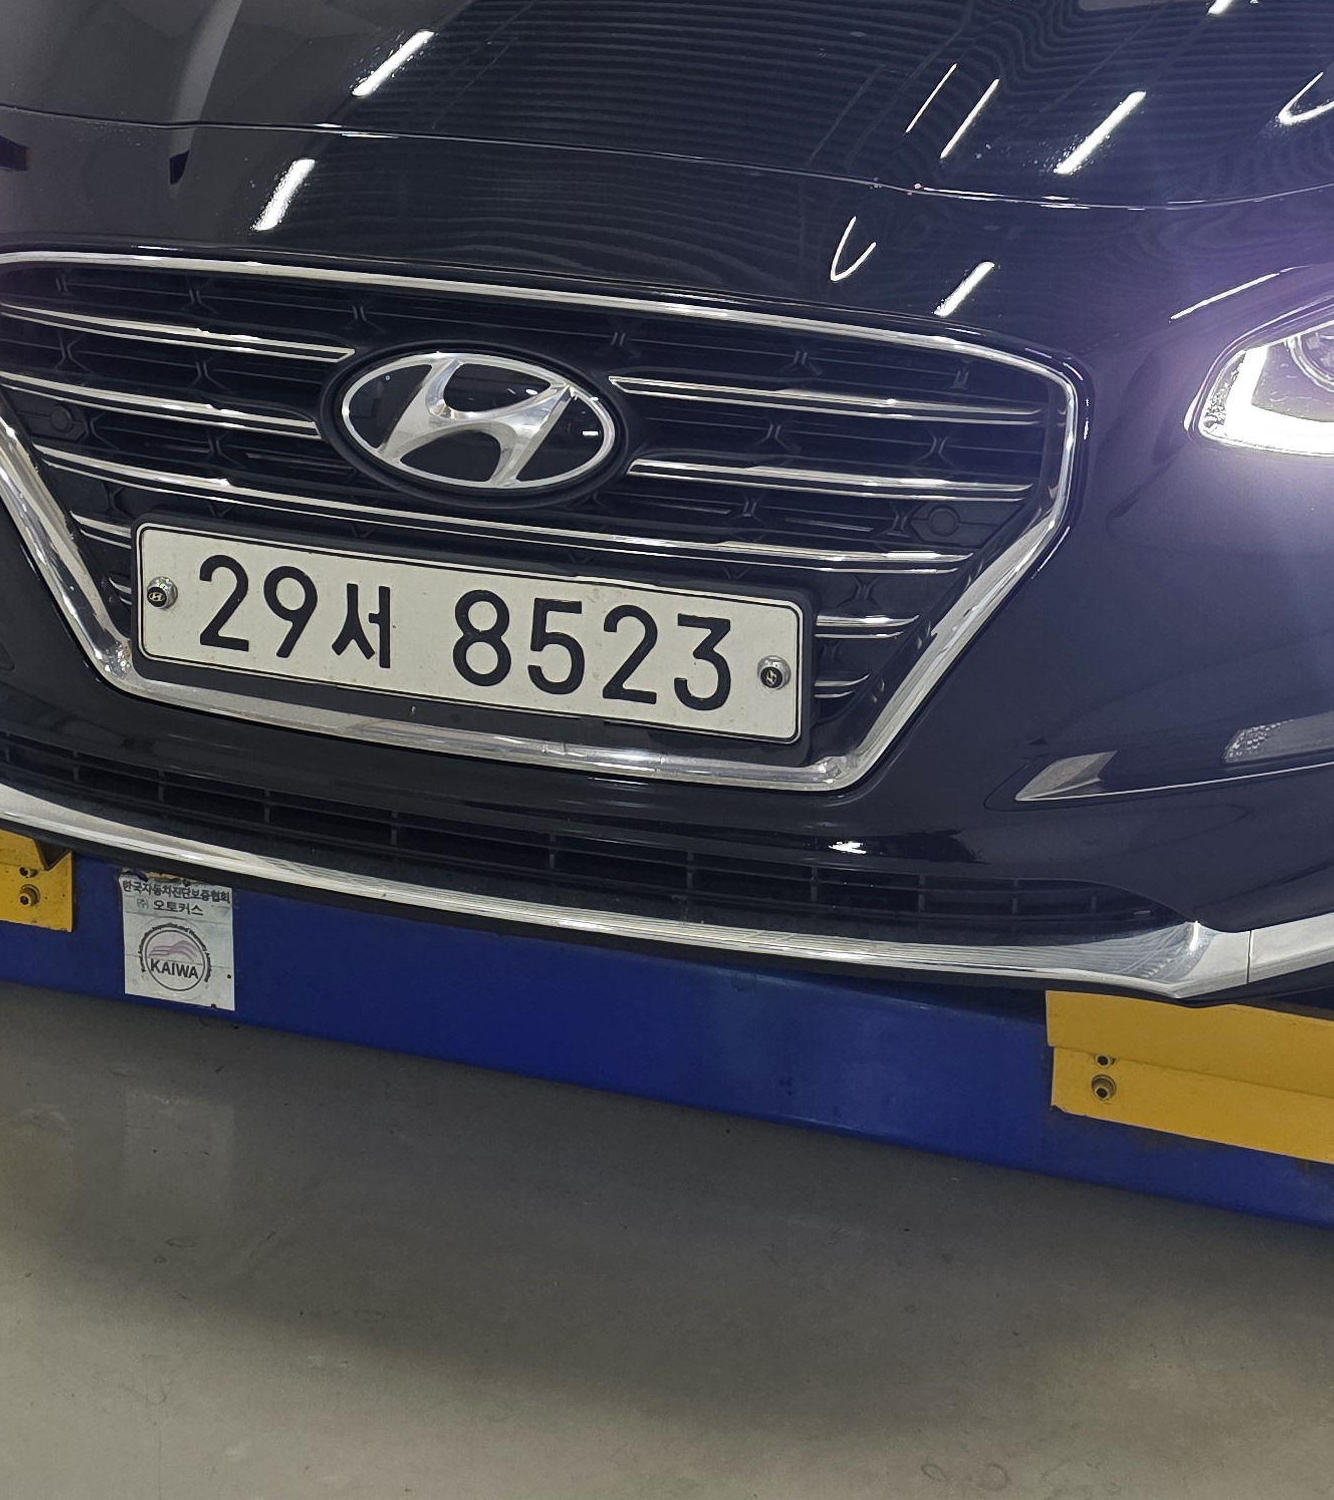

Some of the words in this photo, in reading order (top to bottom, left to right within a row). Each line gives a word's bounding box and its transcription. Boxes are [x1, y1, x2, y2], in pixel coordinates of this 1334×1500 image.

[198, 554, 391, 669] 29서
[451, 589, 733, 712] 8523
[153, 900, 204, 916] 오토커스
[150, 958, 199, 979] KAIWA
